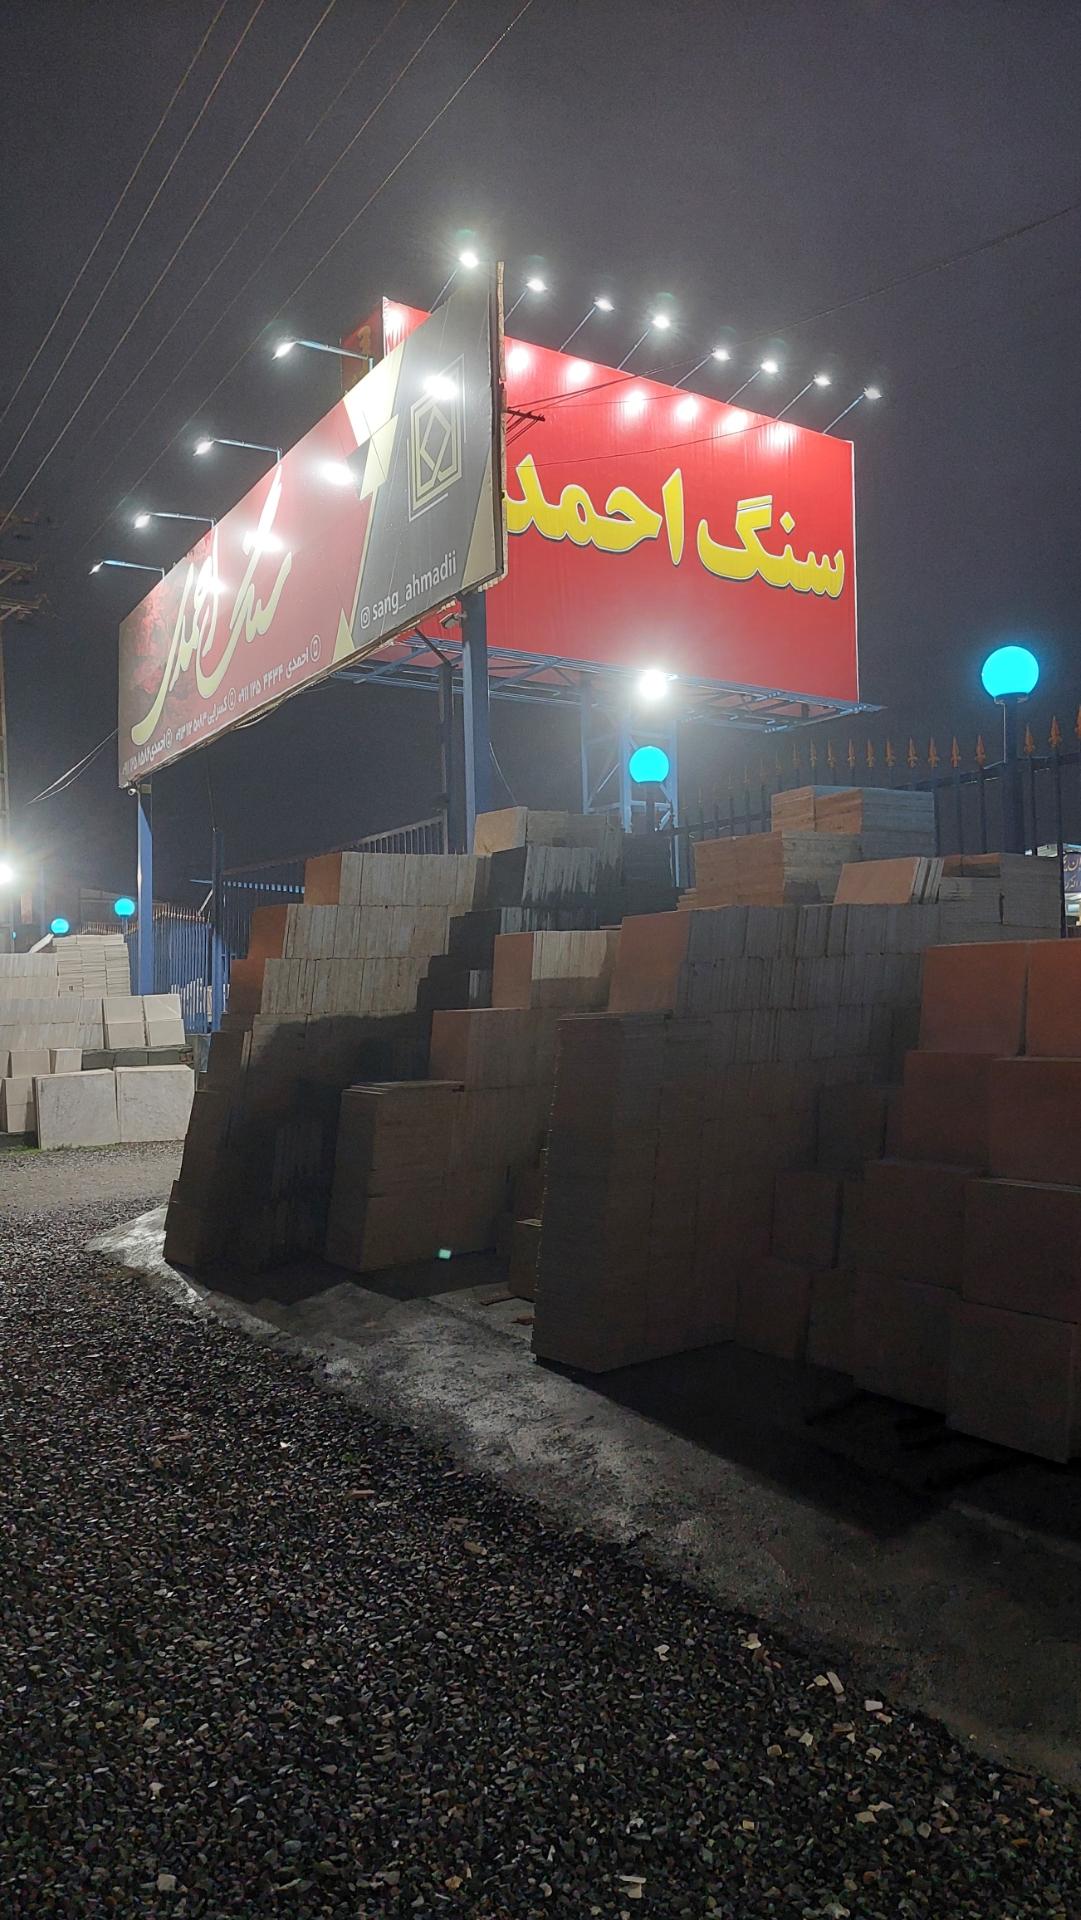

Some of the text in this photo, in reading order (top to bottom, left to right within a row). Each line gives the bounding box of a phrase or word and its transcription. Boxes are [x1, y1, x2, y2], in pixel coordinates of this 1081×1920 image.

[504, 453, 845, 598] سنگ احمد
[196, 462, 292, 700] سنگ
[372, 550, 457, 622] sang_ahmadii
[285, 646, 309, 680] احمدی
